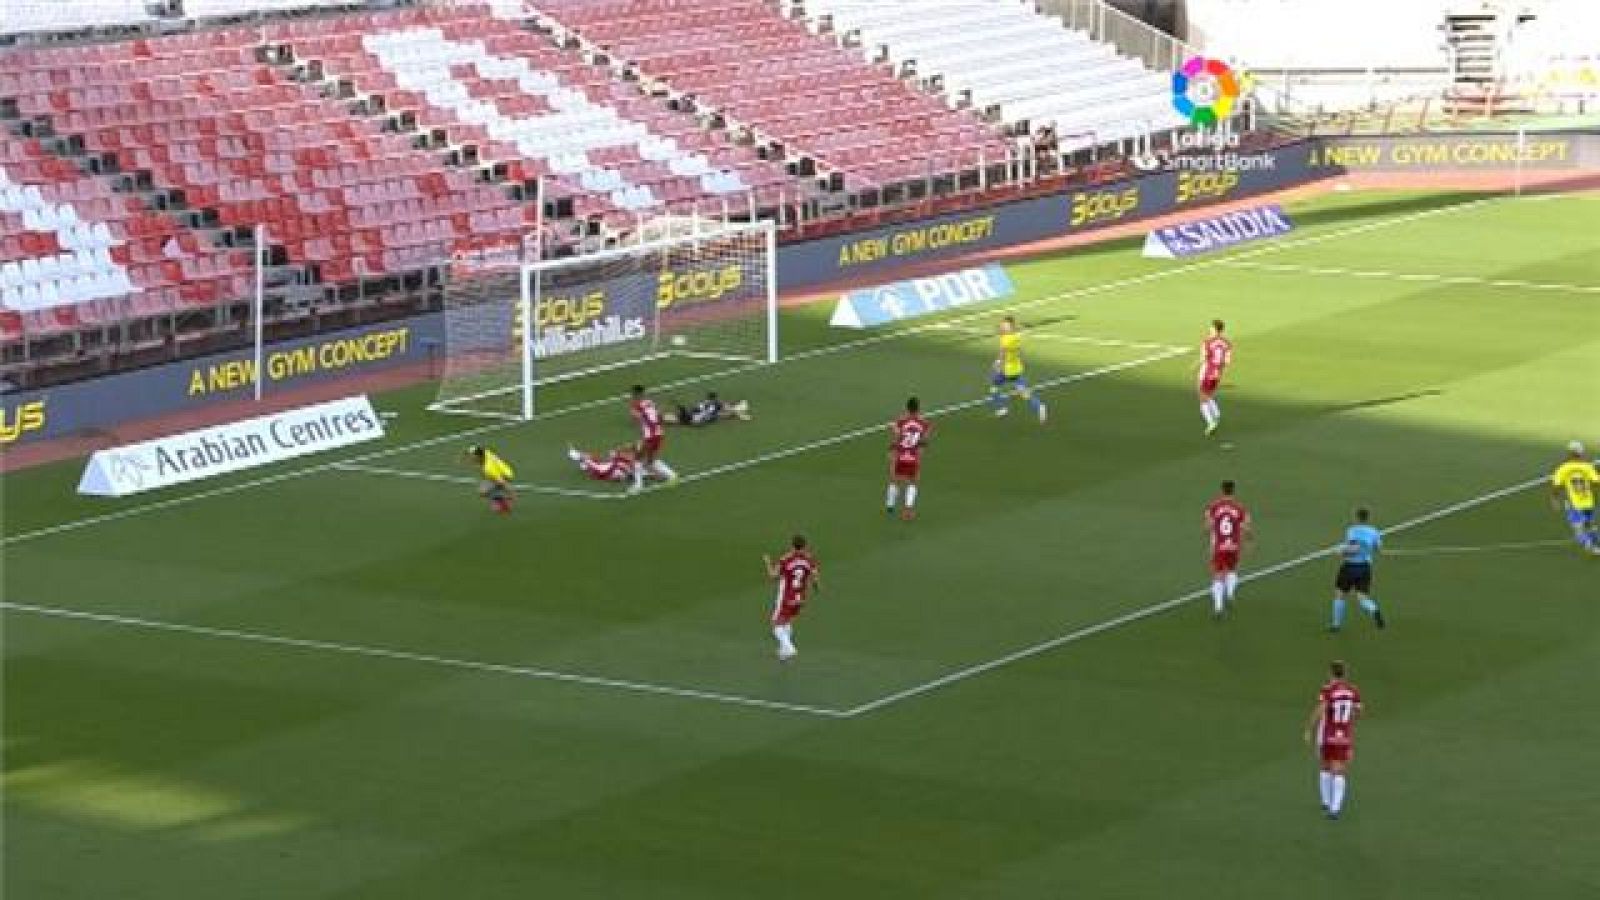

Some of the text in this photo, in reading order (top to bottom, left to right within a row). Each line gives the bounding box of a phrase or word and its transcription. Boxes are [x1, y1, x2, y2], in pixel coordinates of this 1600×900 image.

[1324, 146, 1380, 166] NEW
[1391, 143, 1447, 165] GYM
[850, 239, 888, 260] NEW
[892, 228, 927, 256] GYM
[929, 216, 995, 248] CONCEPT
[188, 330, 409, 396] A NEW GYM CONCEPT
[155, 410, 374, 476] Arabian Centres
